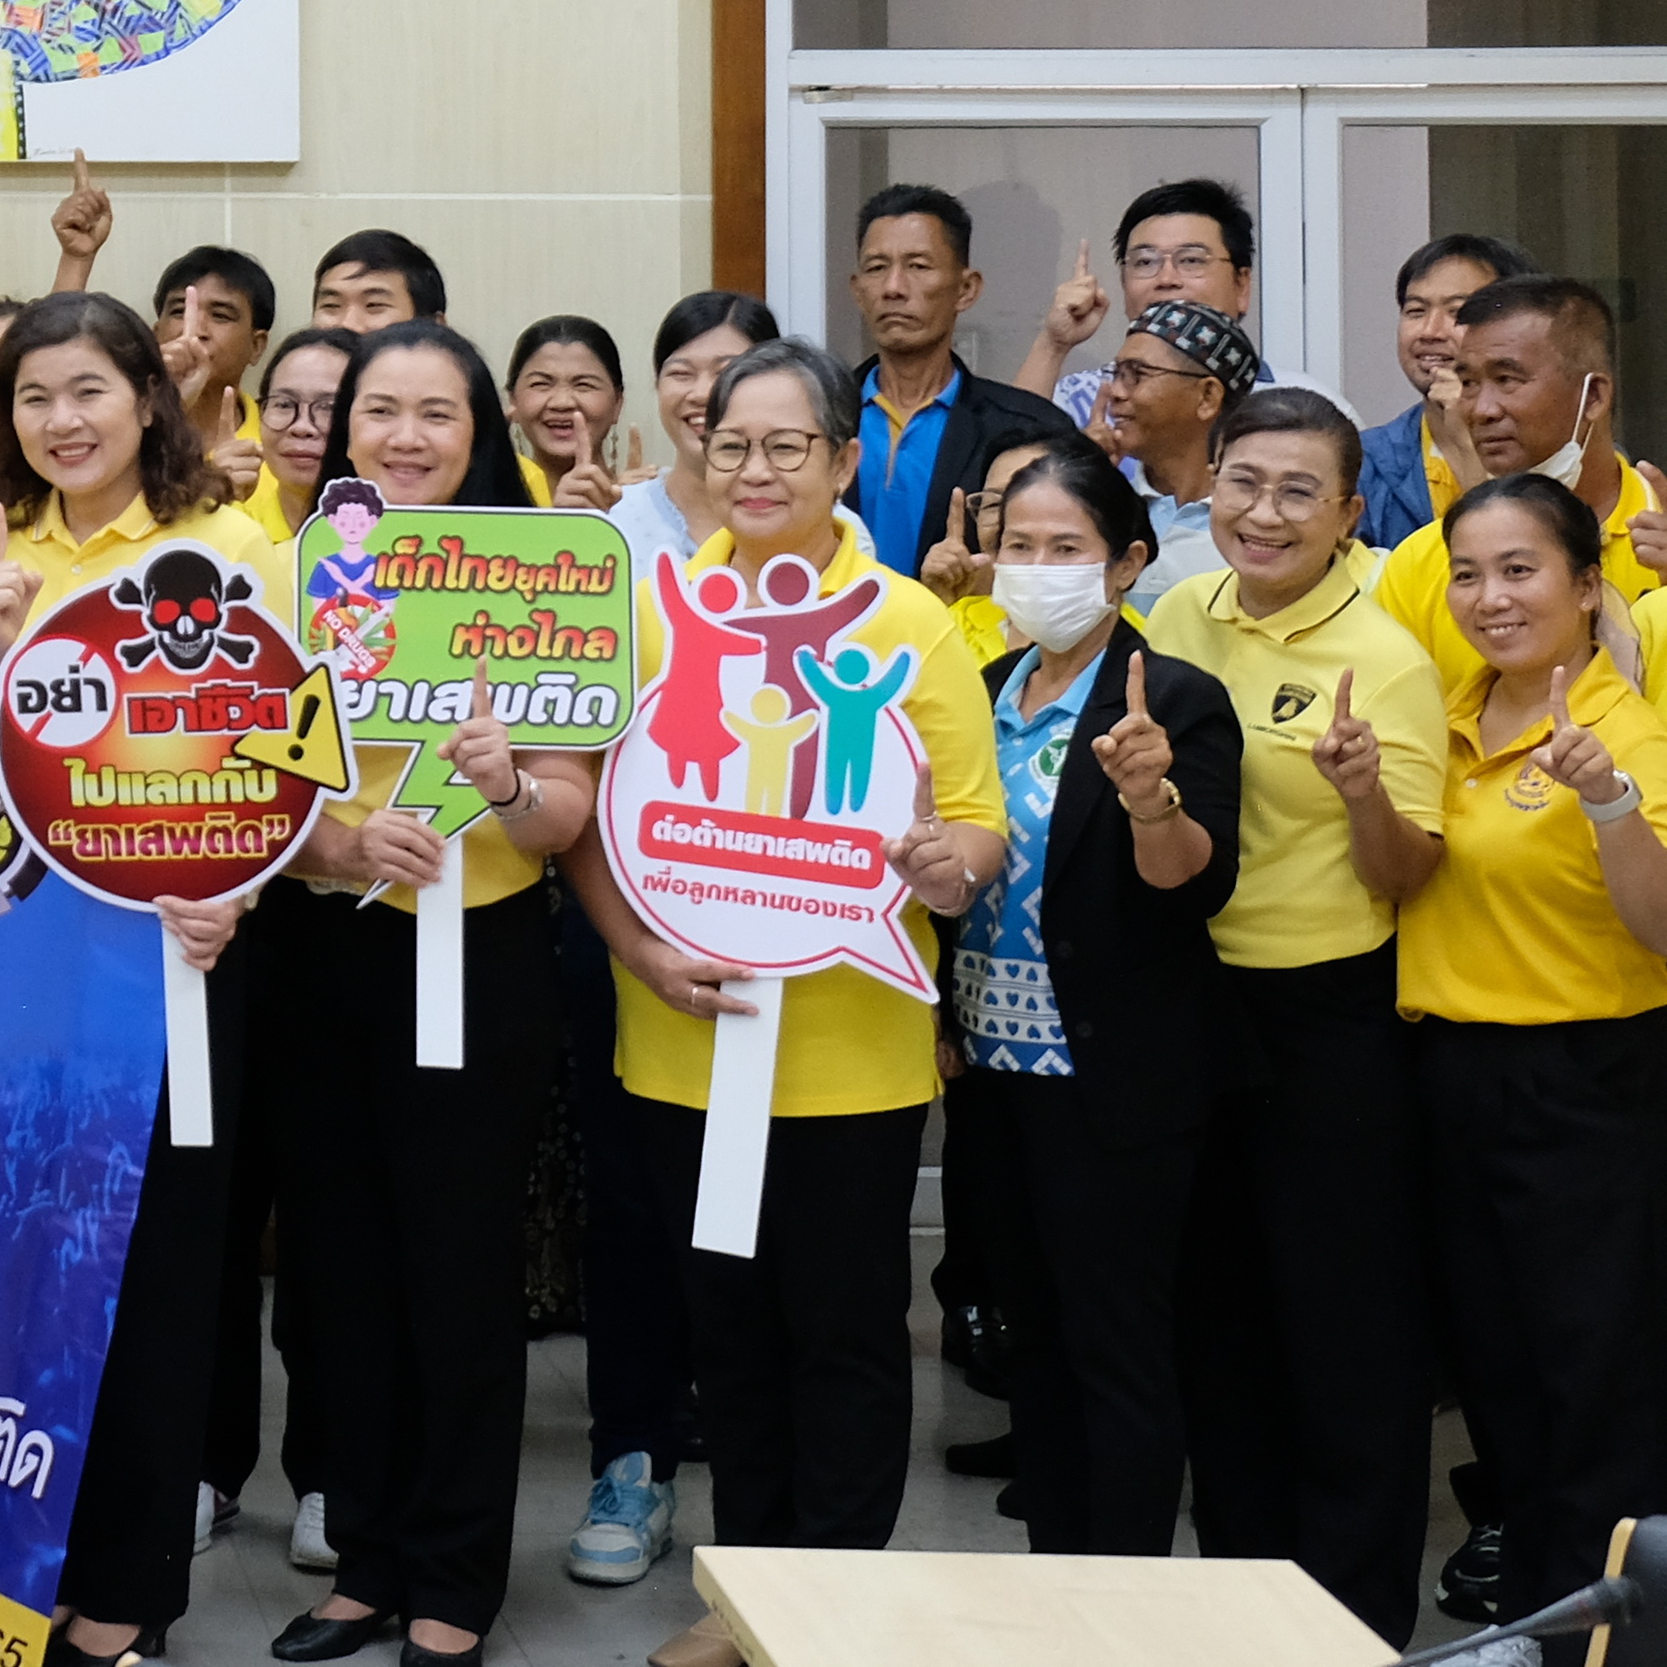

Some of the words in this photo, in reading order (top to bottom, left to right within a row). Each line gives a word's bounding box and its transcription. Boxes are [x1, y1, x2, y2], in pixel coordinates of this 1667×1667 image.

[450, 609, 618, 661] ห่างไกล
[17, 665, 108, 714] อย่า
[63, 757, 279, 807] ไปแลกกับ
[651, 814, 872, 870] ต่อต้านยาเสพติด
[642, 866, 875, 924] เพื่อลูกหลานของเรา
